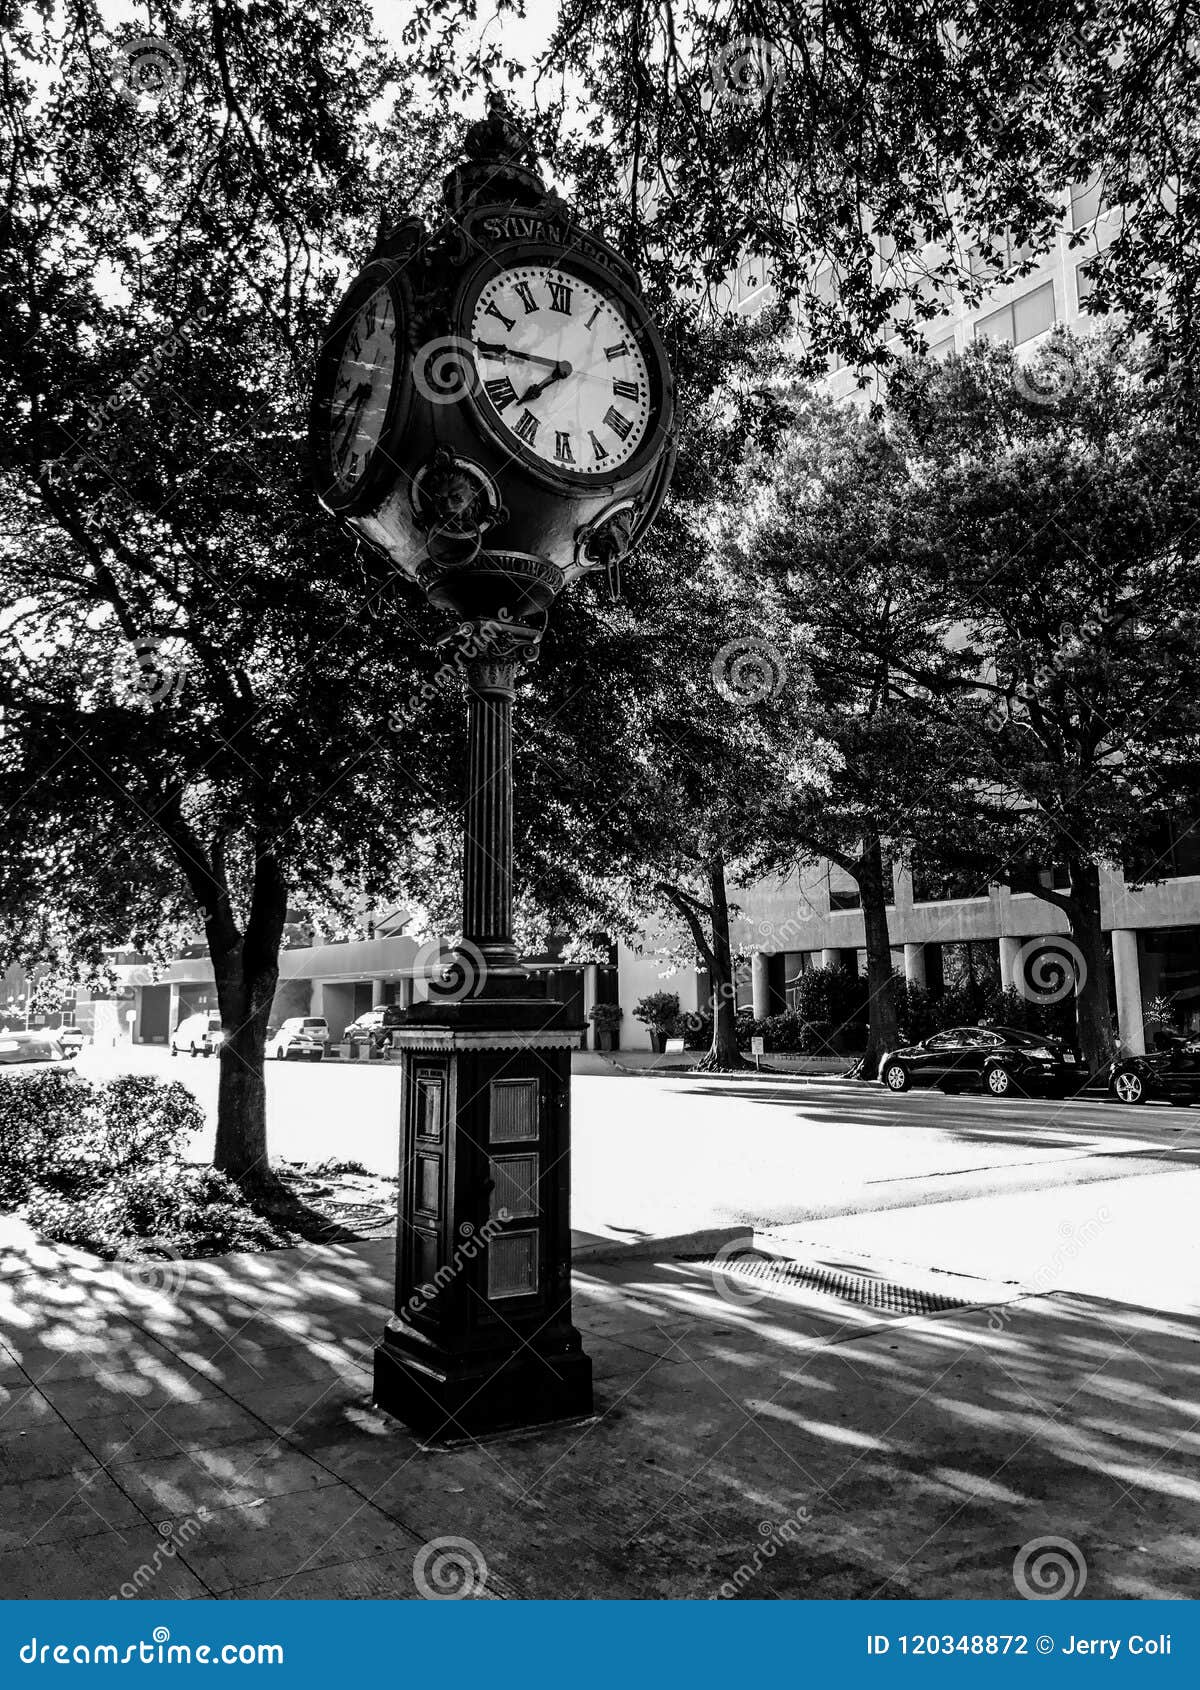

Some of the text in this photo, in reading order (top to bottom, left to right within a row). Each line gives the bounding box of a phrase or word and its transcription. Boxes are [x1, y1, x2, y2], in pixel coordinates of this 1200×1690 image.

[483, 217, 561, 243] SYLVAN
[511, 281, 540, 315] XI
[546, 281, 573, 316] XII
[484, 300, 516, 332] X
[584, 305, 603, 331] I
[604, 340, 631, 362] II
[612, 376, 639, 403] III
[587, 430, 610, 461] V
